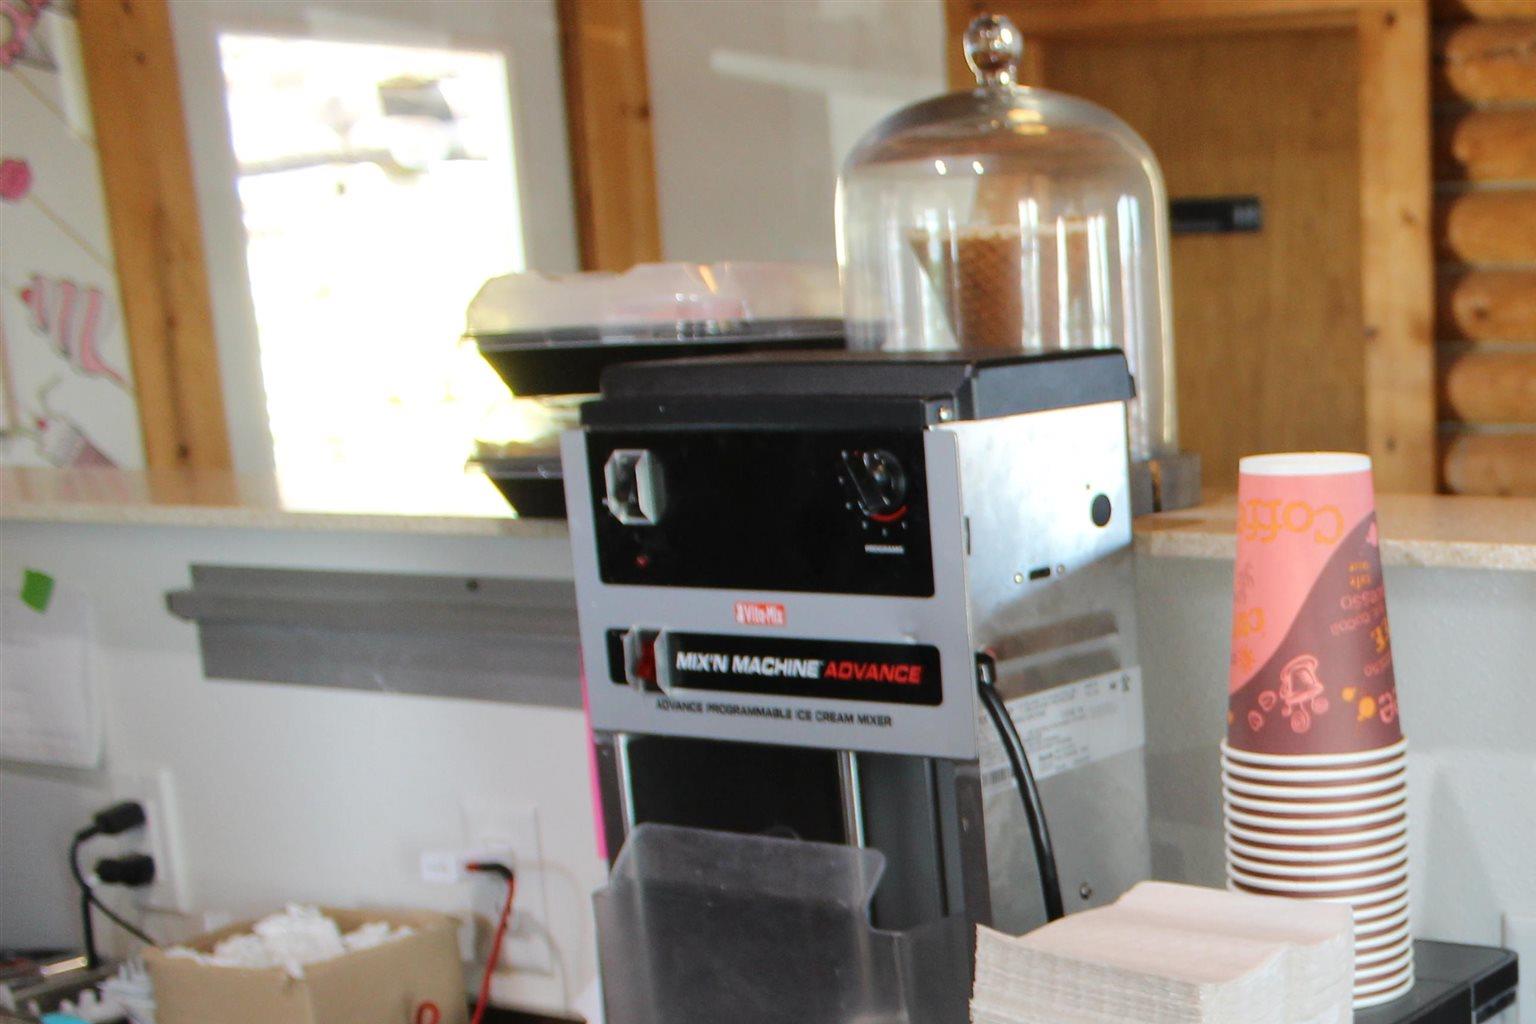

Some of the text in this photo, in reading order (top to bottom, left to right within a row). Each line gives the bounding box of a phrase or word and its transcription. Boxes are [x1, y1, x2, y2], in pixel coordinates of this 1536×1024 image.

[676, 651, 923, 685] MIX'N MACHINE ADVANCE
[656, 699, 892, 727] ADVANCE PROGRAMMABLE ICE CREAM MIXER
